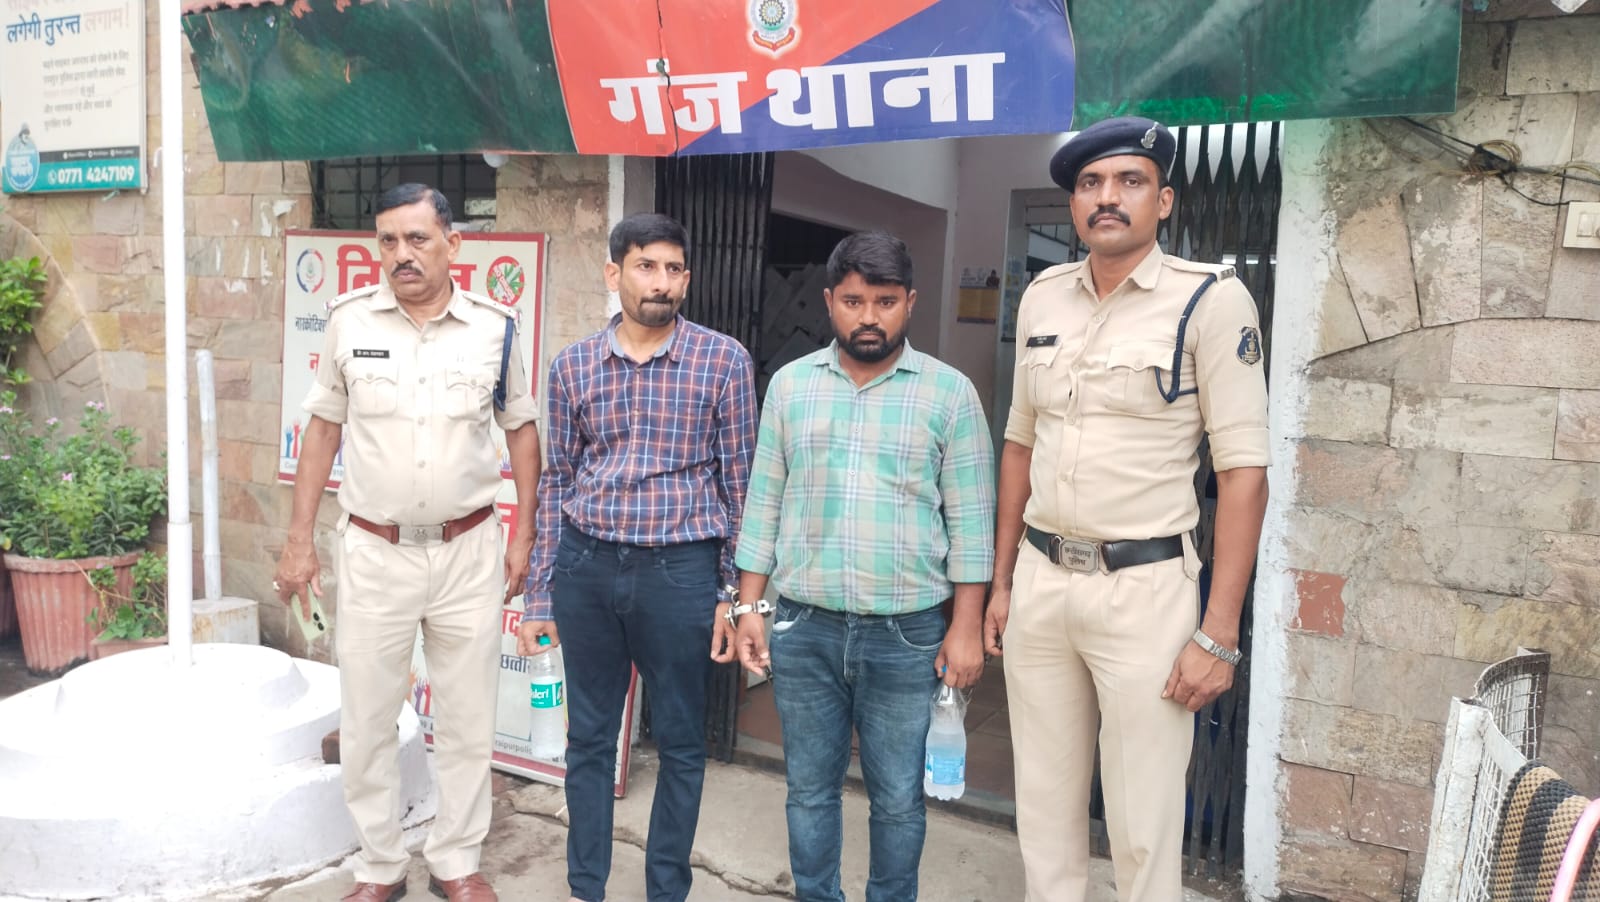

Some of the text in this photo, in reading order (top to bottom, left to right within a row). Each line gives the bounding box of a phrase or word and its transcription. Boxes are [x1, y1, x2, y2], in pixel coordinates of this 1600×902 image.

[6, 12, 41, 43] लगेगी
[44, 14, 81, 45] तुरन्त
[600, 52, 1005, 136] गंज थाना
[57, 165, 135, 184] 0771 4247109
